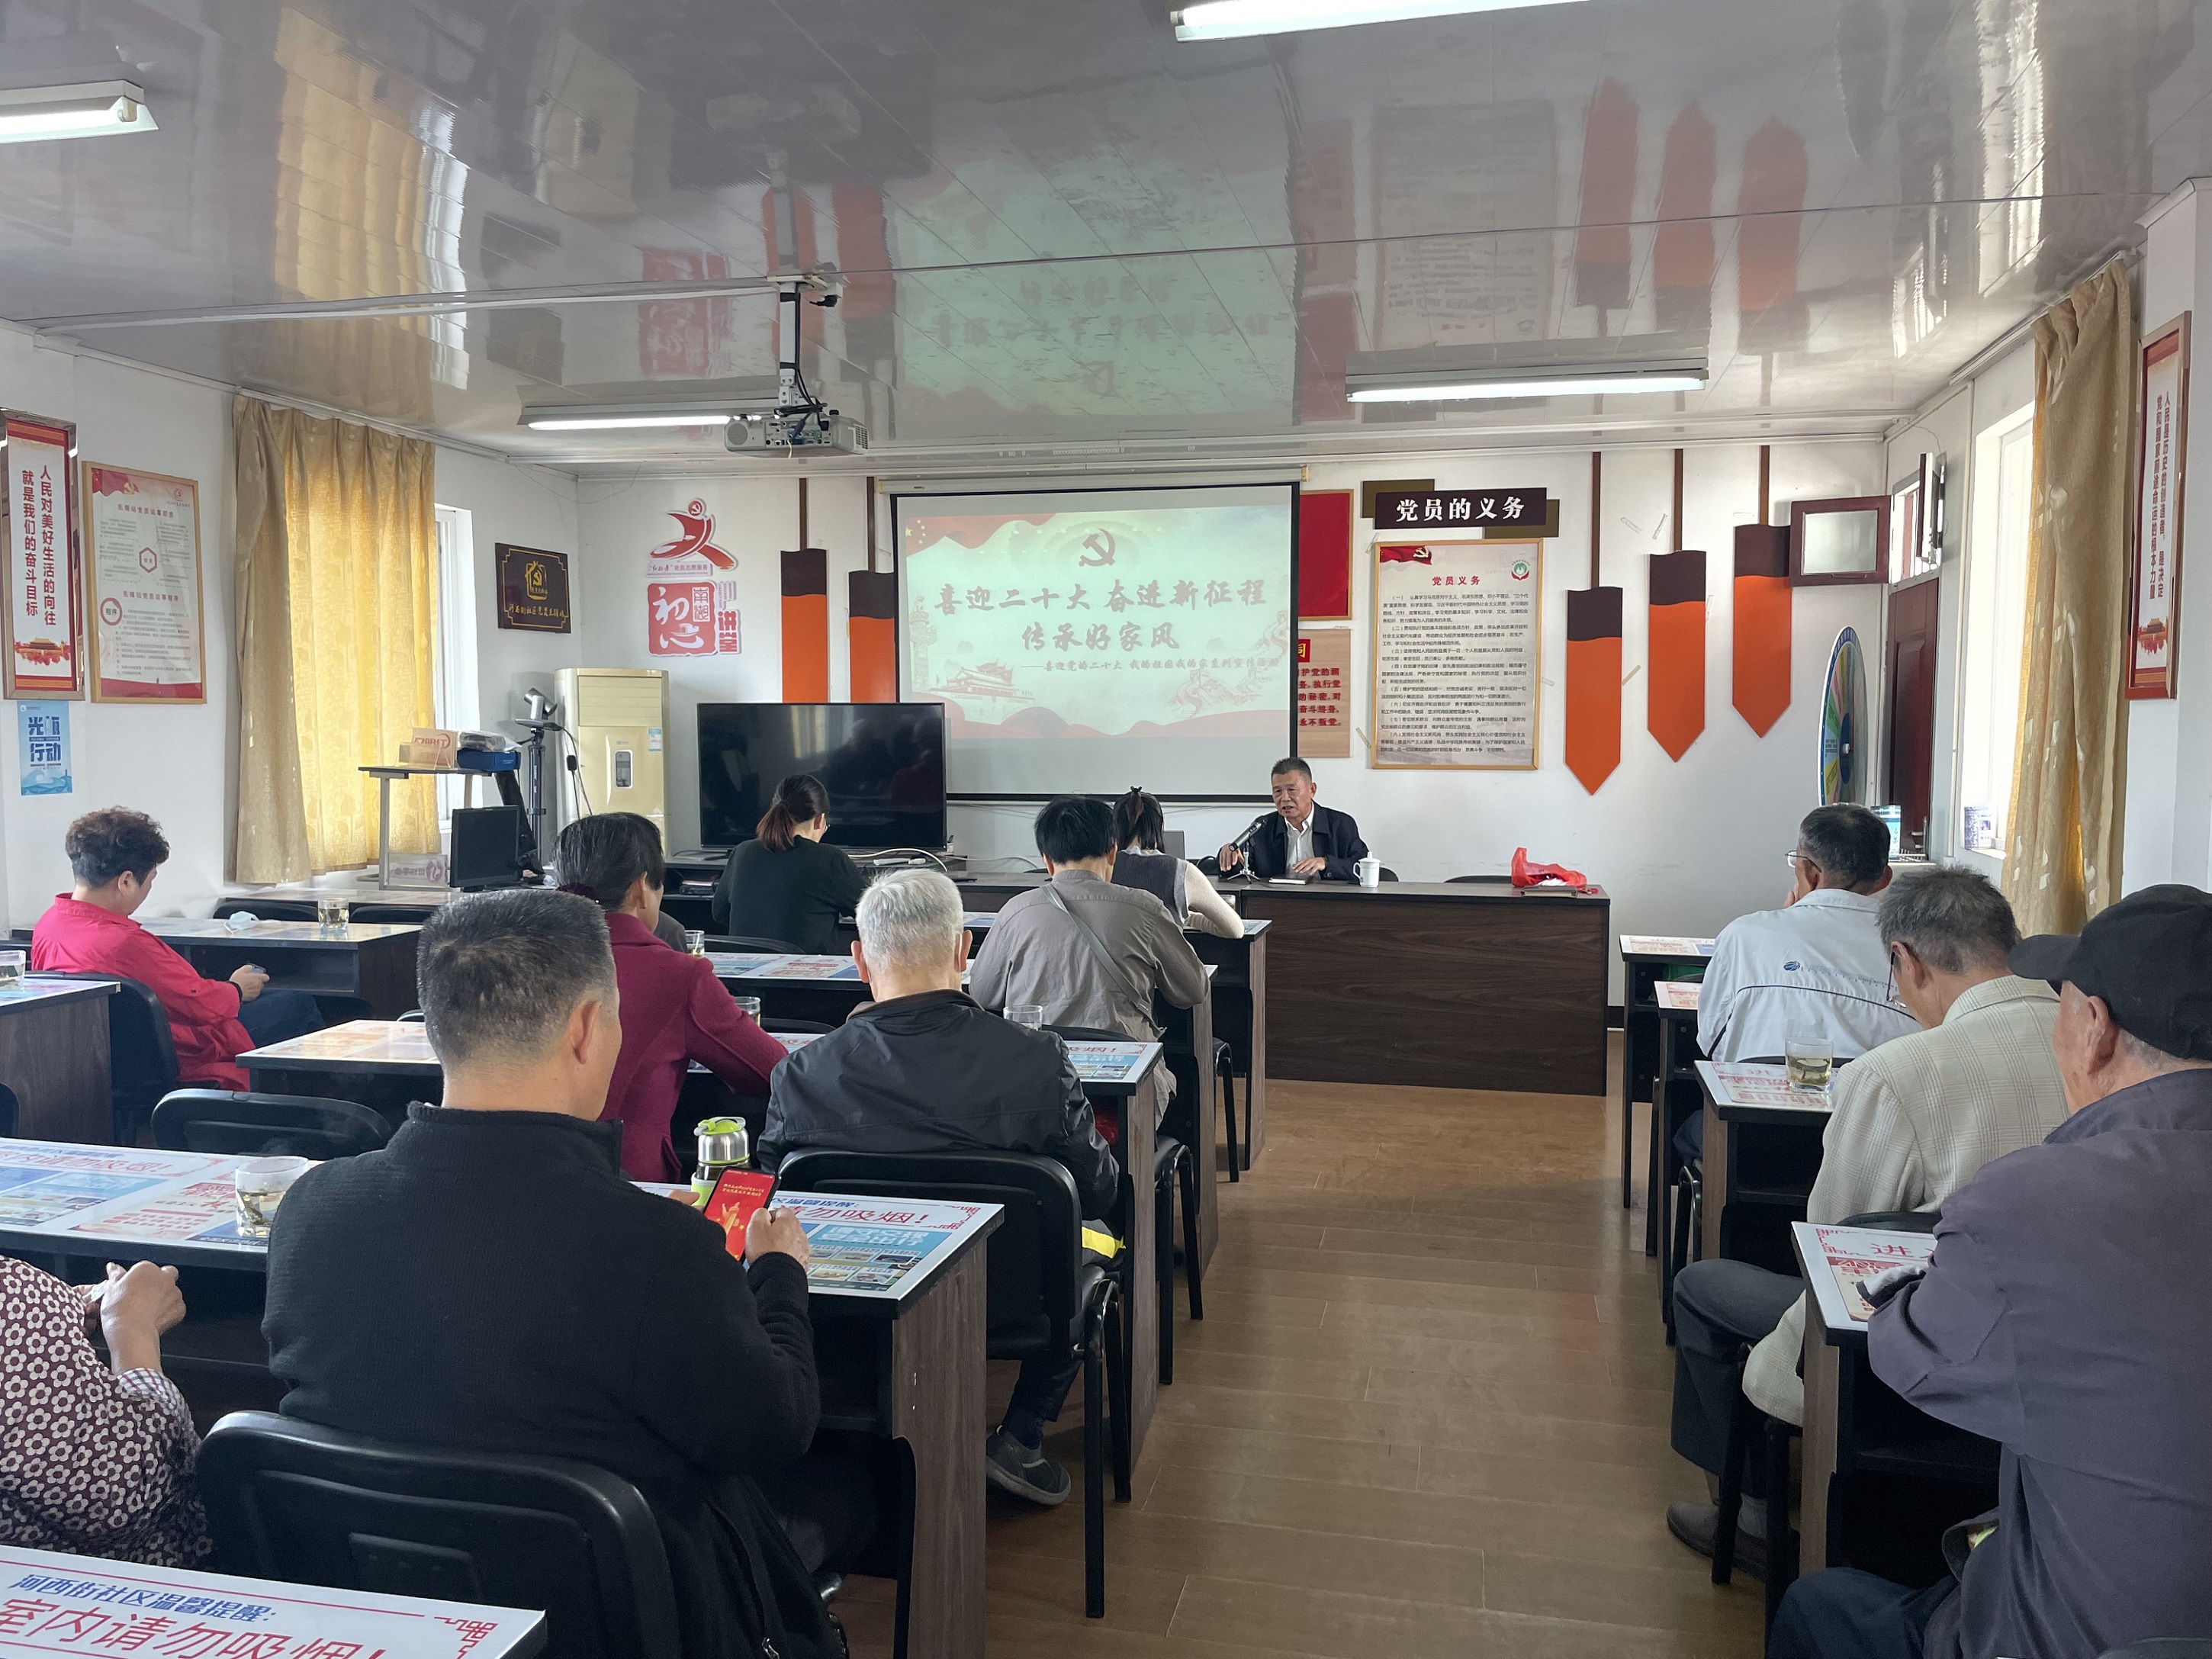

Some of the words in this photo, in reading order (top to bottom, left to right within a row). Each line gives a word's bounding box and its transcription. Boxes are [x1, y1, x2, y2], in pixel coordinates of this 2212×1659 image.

[1396, 496, 1525, 522] 党员的义务
[22, 469, 38, 616] 就是我们的奋斗目标
[40, 465, 56, 626] 人民对美好生活的向往
[934, 582, 1092, 615] 喜迎二十大
[1104, 578, 1267, 612] 奋进新征程
[1432, 576, 1481, 587] 党员义务
[105, 607, 117, 616] 程序
[652, 586, 705, 649] 初心
[1021, 621, 1179, 652] 传承好家风
[30, 742, 61, 762] 行动
[8, 1574, 277, 1623] 河西街社区温馨提醒：
